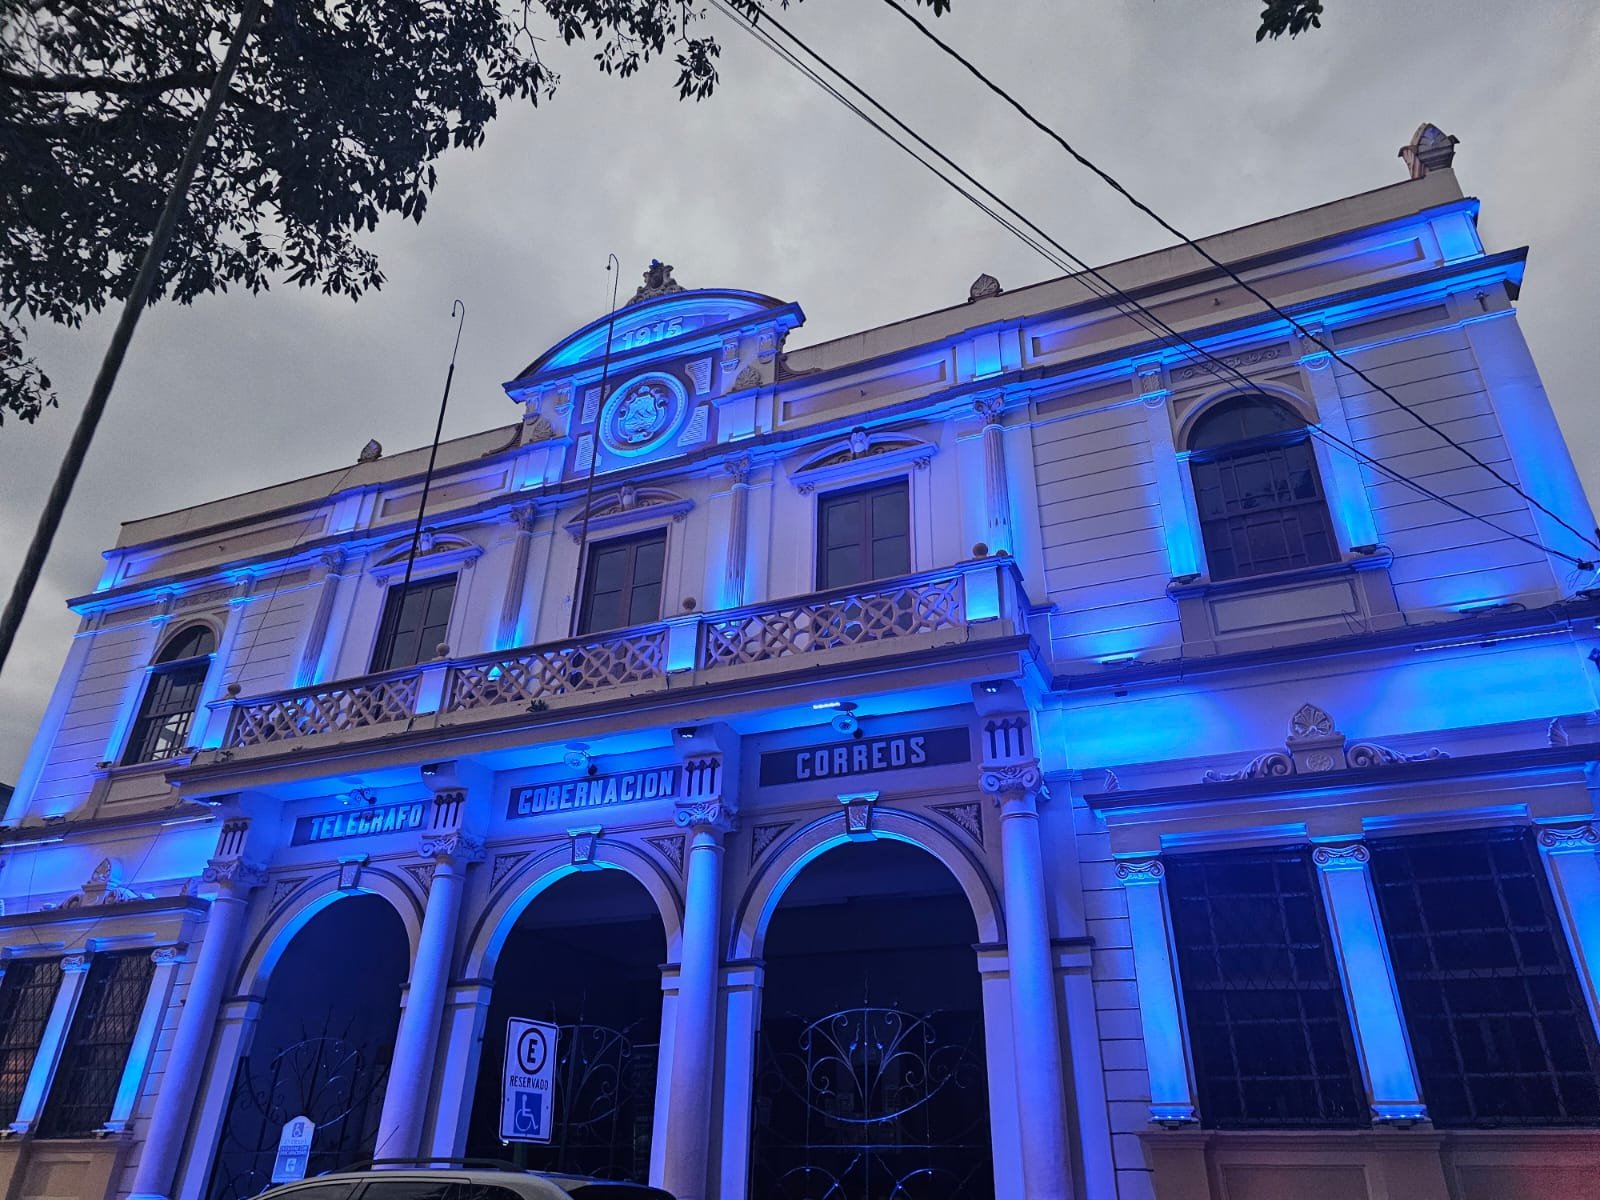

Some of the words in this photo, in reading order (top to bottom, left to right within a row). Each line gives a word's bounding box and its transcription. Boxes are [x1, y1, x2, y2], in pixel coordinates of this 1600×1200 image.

[623, 317, 683, 350] 1915
[797, 736, 926, 779] CORREOS
[517, 770, 673, 815] GOBERNACION
[310, 804, 423, 840] TELEGRAFO
[527, 1038, 538, 1064] E
[509, 1075, 549, 1091] RESERVADO
